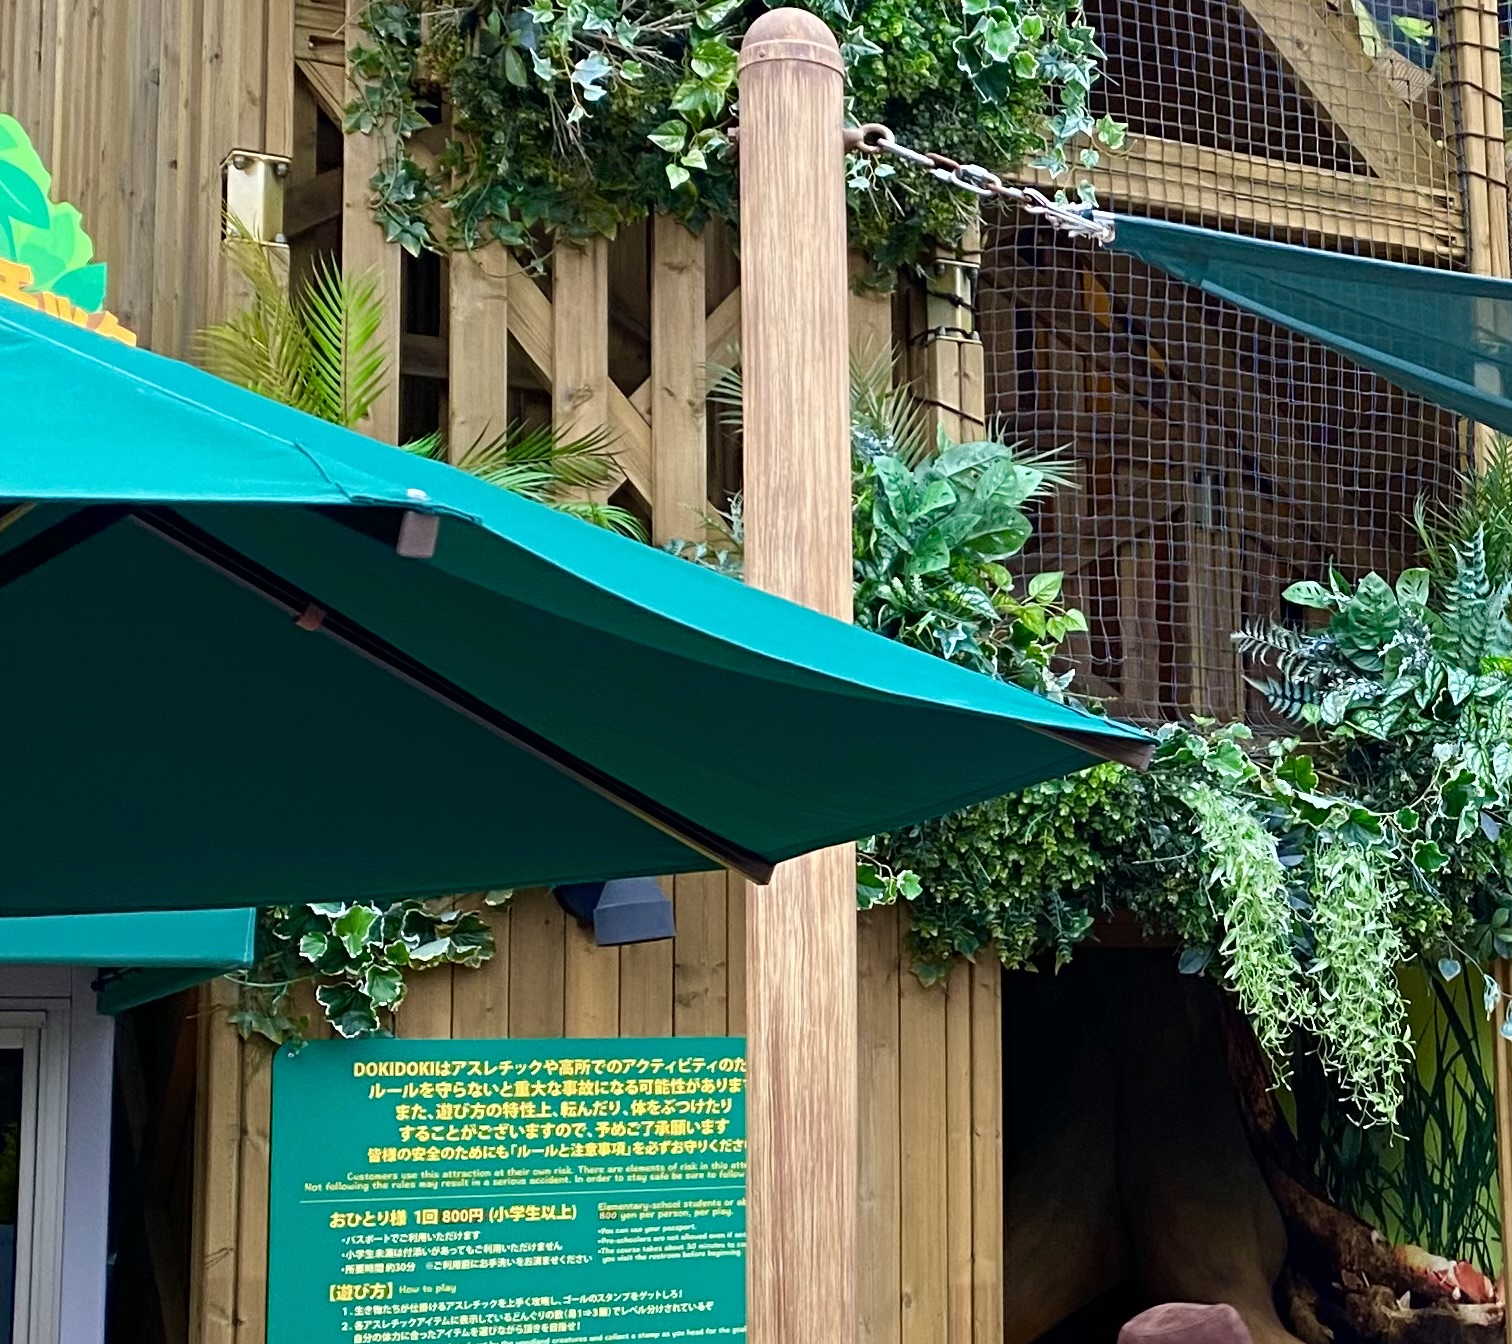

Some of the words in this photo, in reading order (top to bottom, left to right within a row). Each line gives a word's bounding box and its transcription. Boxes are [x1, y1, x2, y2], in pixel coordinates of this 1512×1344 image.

[354, 1057, 745, 1076] DOKIDOKIはアスレチックや高所でのアクティビティのた
[369, 1076, 746, 1098] ルールを守らないと重大な事故になる可能性がありま
[396, 1098, 732, 1120] また、遊び方の特性上、転んだり、体をぶつけたり
[400, 1118, 729, 1142] することがございますので、予めご了承願います
[304, 1183, 322, 1191] Not
[325, 1179, 369, 1192] following
[370, 1178, 388, 1189] the
[391, 1178, 416, 1188] rules
[418, 1177, 438, 1189] may
[441, 1176, 470, 1187] result
[470, 1176, 482, 1185] in
[482, 1176, 489, 1186] a
[492, 1174, 526, 1185] serious
[529, 1173, 571, 1184] accident.
[586, 1172, 612, 1182] order
[614, 1172, 624, 1181] to
[627, 1171, 647, 1183] stay
[648, 1170, 670, 1180] safe
[671, 1170, 682, 1179] be
[685, 1170, 704, 1179] sure
[707, 1169, 716, 1178] to
[719, 1168, 745, 1178] follow
[347, 1172, 398, 1182] Customers
[401, 1172, 417, 1181] use
[420, 1170, 439, 1178] this
[442, 1169, 491, 1179] attraction
[506, 1167, 530, 1178] their
[554, 1166, 576, 1176] risk.
[578, 1165, 604, 1175] There
[625, 1164, 665, 1174] elements
[667, 1162, 677, 1173] of
[680, 1162, 697, 1170] risk
[699, 1162, 708, 1170] in
[711, 1161, 728, 1172] this
[330, 1209, 406, 1228] おひとり様
[414, 1209, 438, 1224] 1回
[442, 1208, 483, 1223] 800円
[488, 1204, 576, 1223] (小学生以上)
